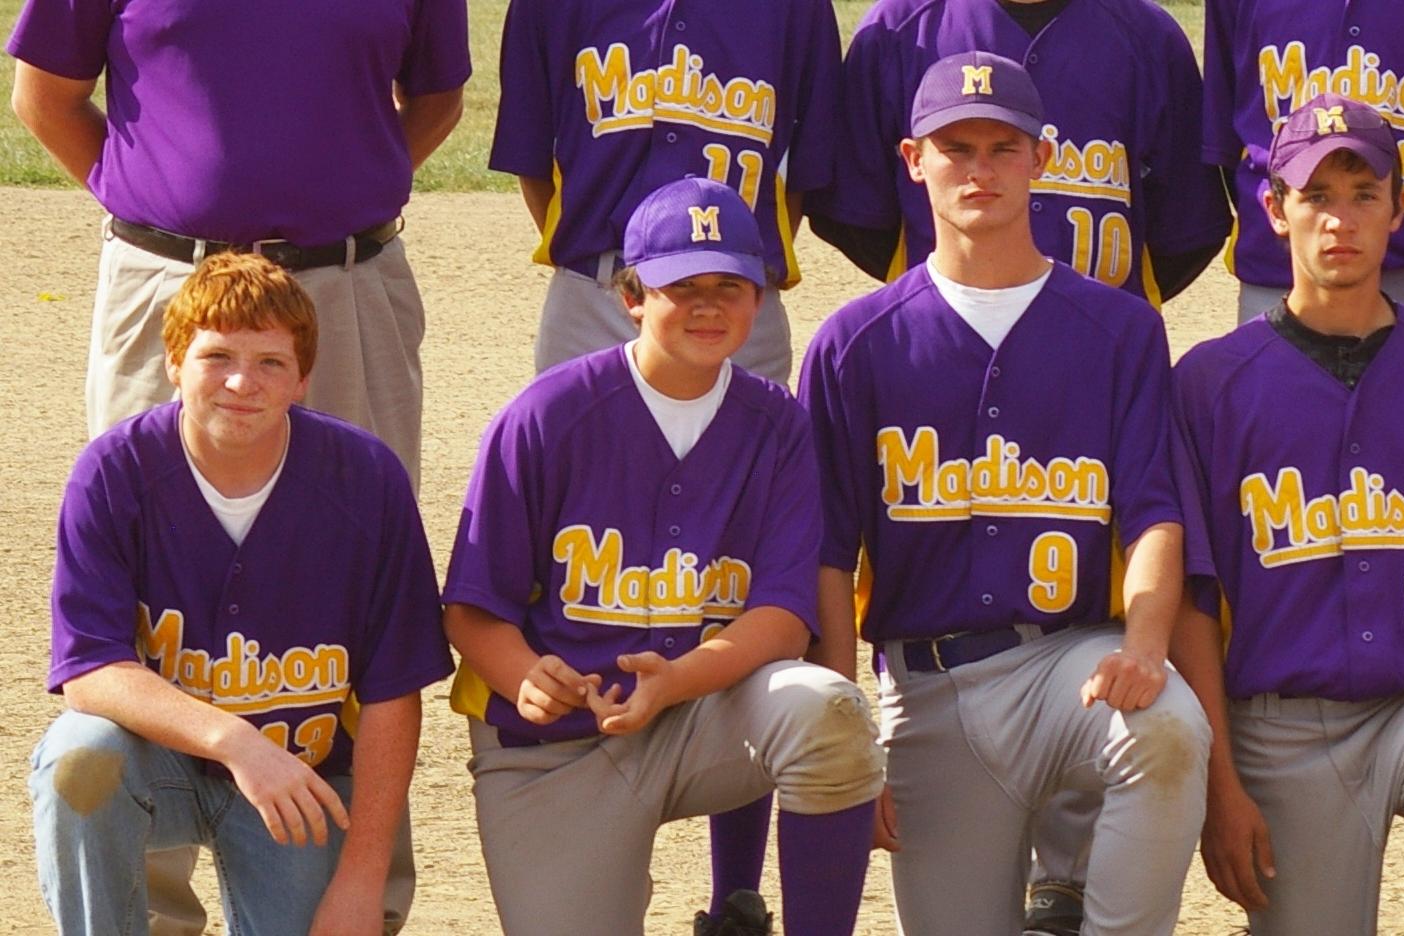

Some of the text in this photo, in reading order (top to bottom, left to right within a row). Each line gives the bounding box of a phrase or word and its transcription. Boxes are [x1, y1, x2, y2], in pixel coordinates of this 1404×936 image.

[576, 43, 776, 127] Madison
[961, 65, 994, 96] M
[688, 206, 722, 243] M
[1066, 206, 1132, 288] 10
[876, 426, 1110, 506] Madison
[1028, 531, 1078, 613] 9
[134, 601, 349, 699] Madison
